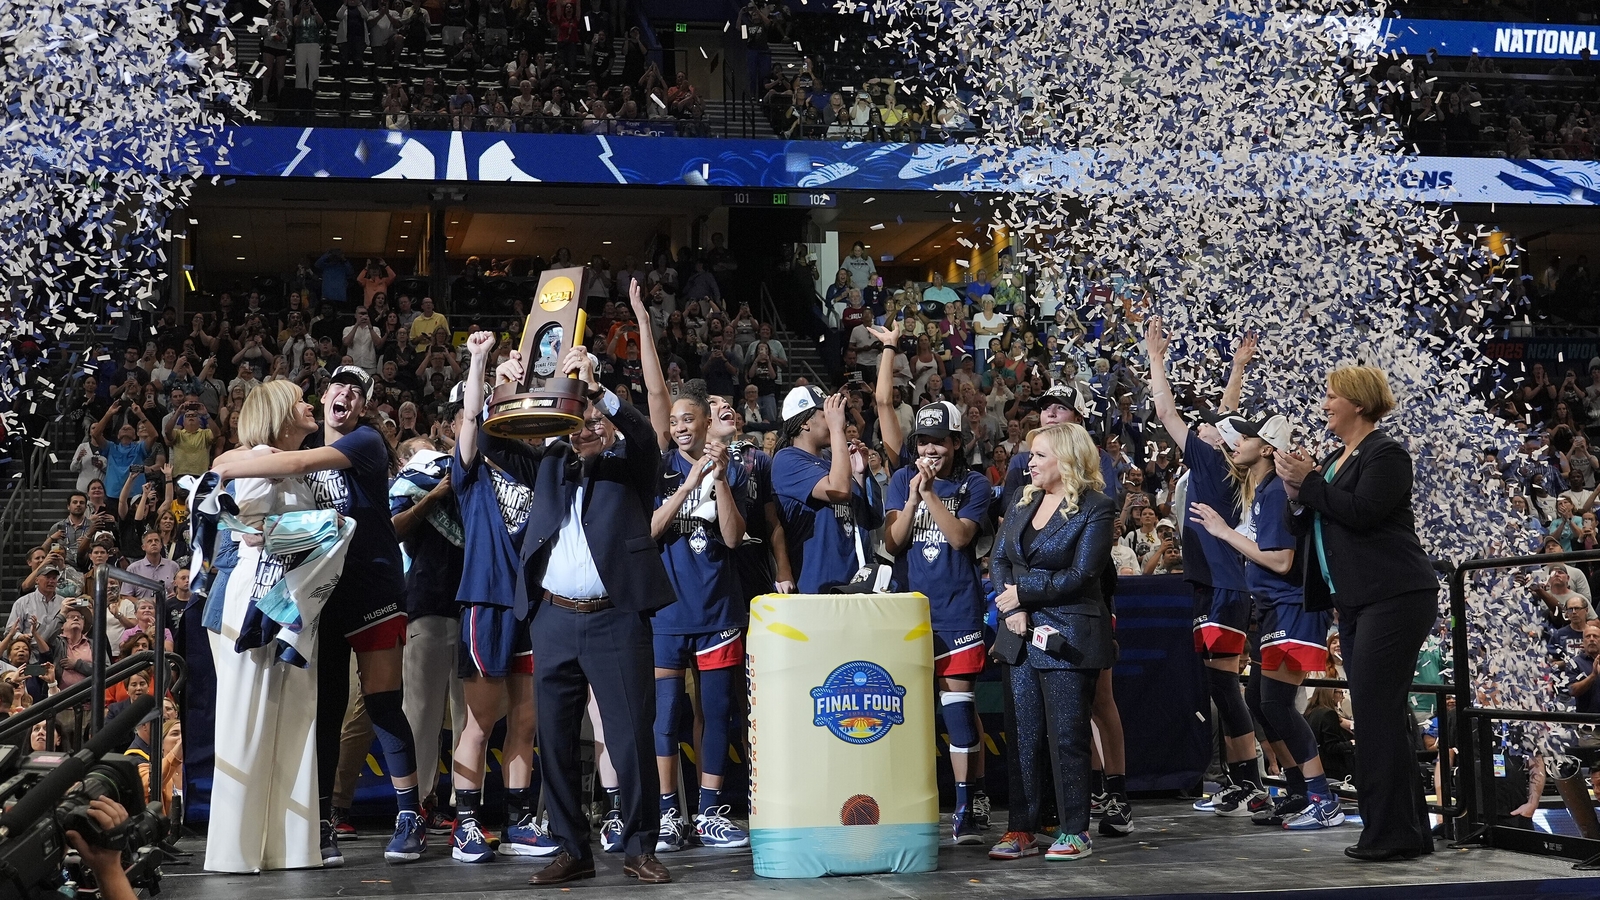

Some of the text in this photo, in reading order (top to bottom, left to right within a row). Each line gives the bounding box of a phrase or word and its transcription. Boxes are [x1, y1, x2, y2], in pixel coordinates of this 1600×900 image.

[675, 23, 687, 32] EXIT
[1494, 28, 1599, 56] NATIONAL
[734, 193, 750, 204] 101
[773, 193, 788, 205] EXIT
[809, 194, 827, 206] 102
[540, 291, 572, 305] NCAA
[1486, 343, 1524, 359] 2025
[1526, 343, 1564, 359] NCAA
[672, 387, 678, 396] 5
[363, 602, 398, 621] HUSKIES
[816, 694, 901, 715] FINAL FOUR
